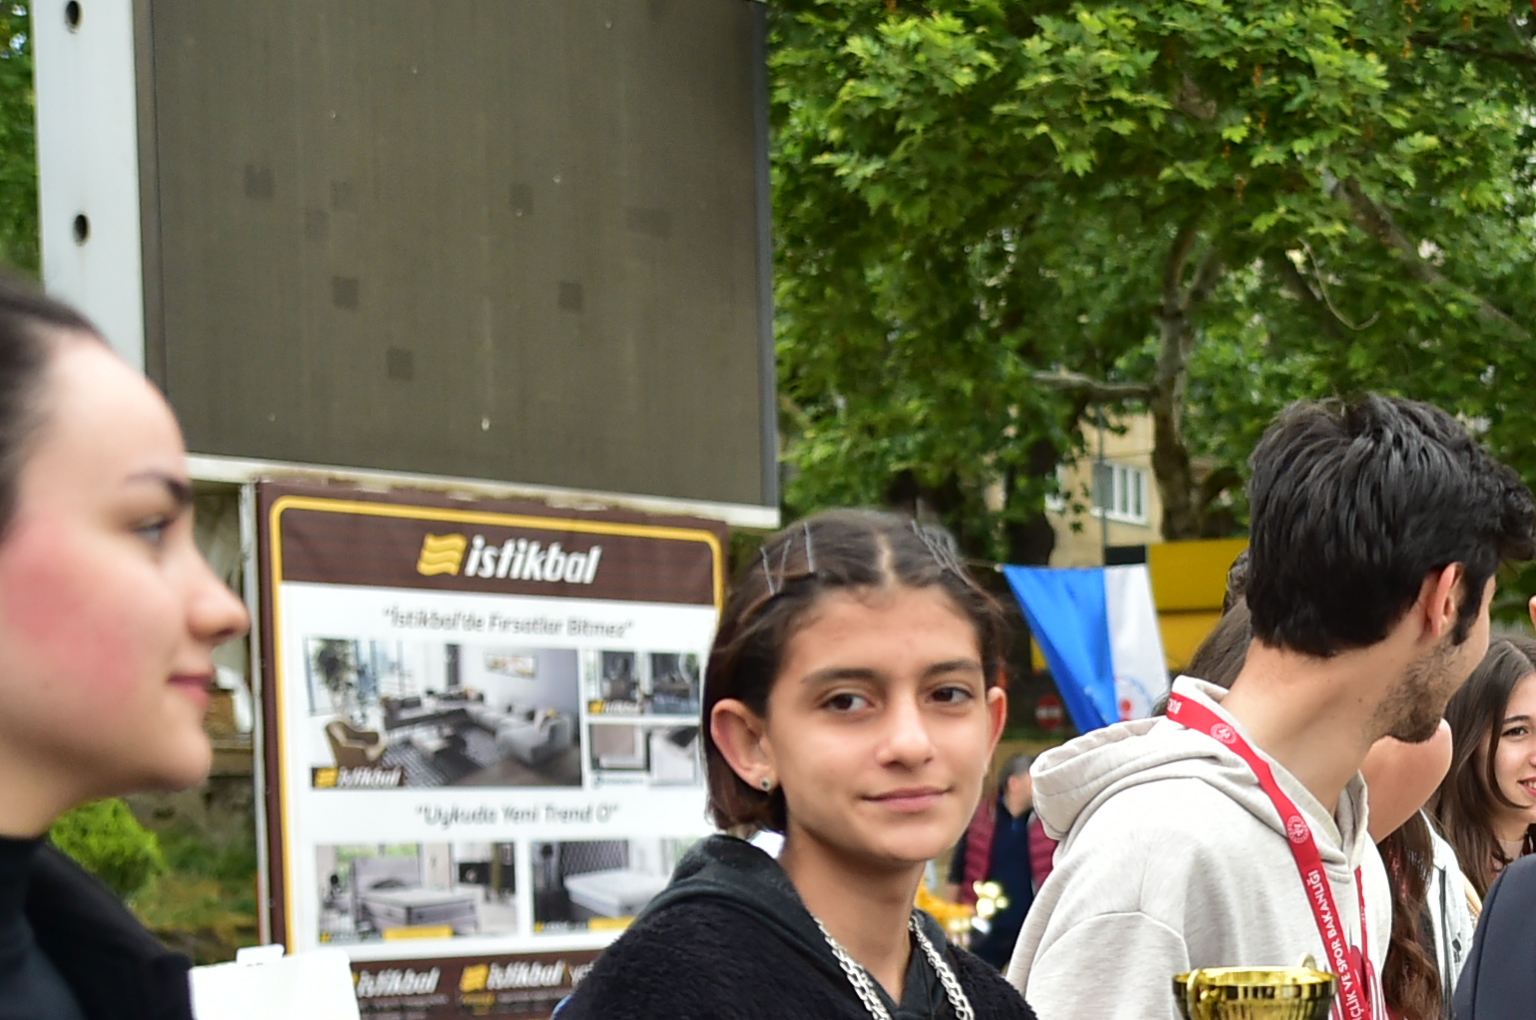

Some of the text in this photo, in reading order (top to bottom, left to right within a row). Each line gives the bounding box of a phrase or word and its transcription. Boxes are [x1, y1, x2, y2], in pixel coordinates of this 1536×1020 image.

[464, 534, 602, 584] istikbal
[1306, 869, 1338, 939] BAKANLIĞI
[1331, 938, 1348, 973] SPOR
[487, 960, 566, 990] istikbal
[1341, 973, 1353, 991] VE
